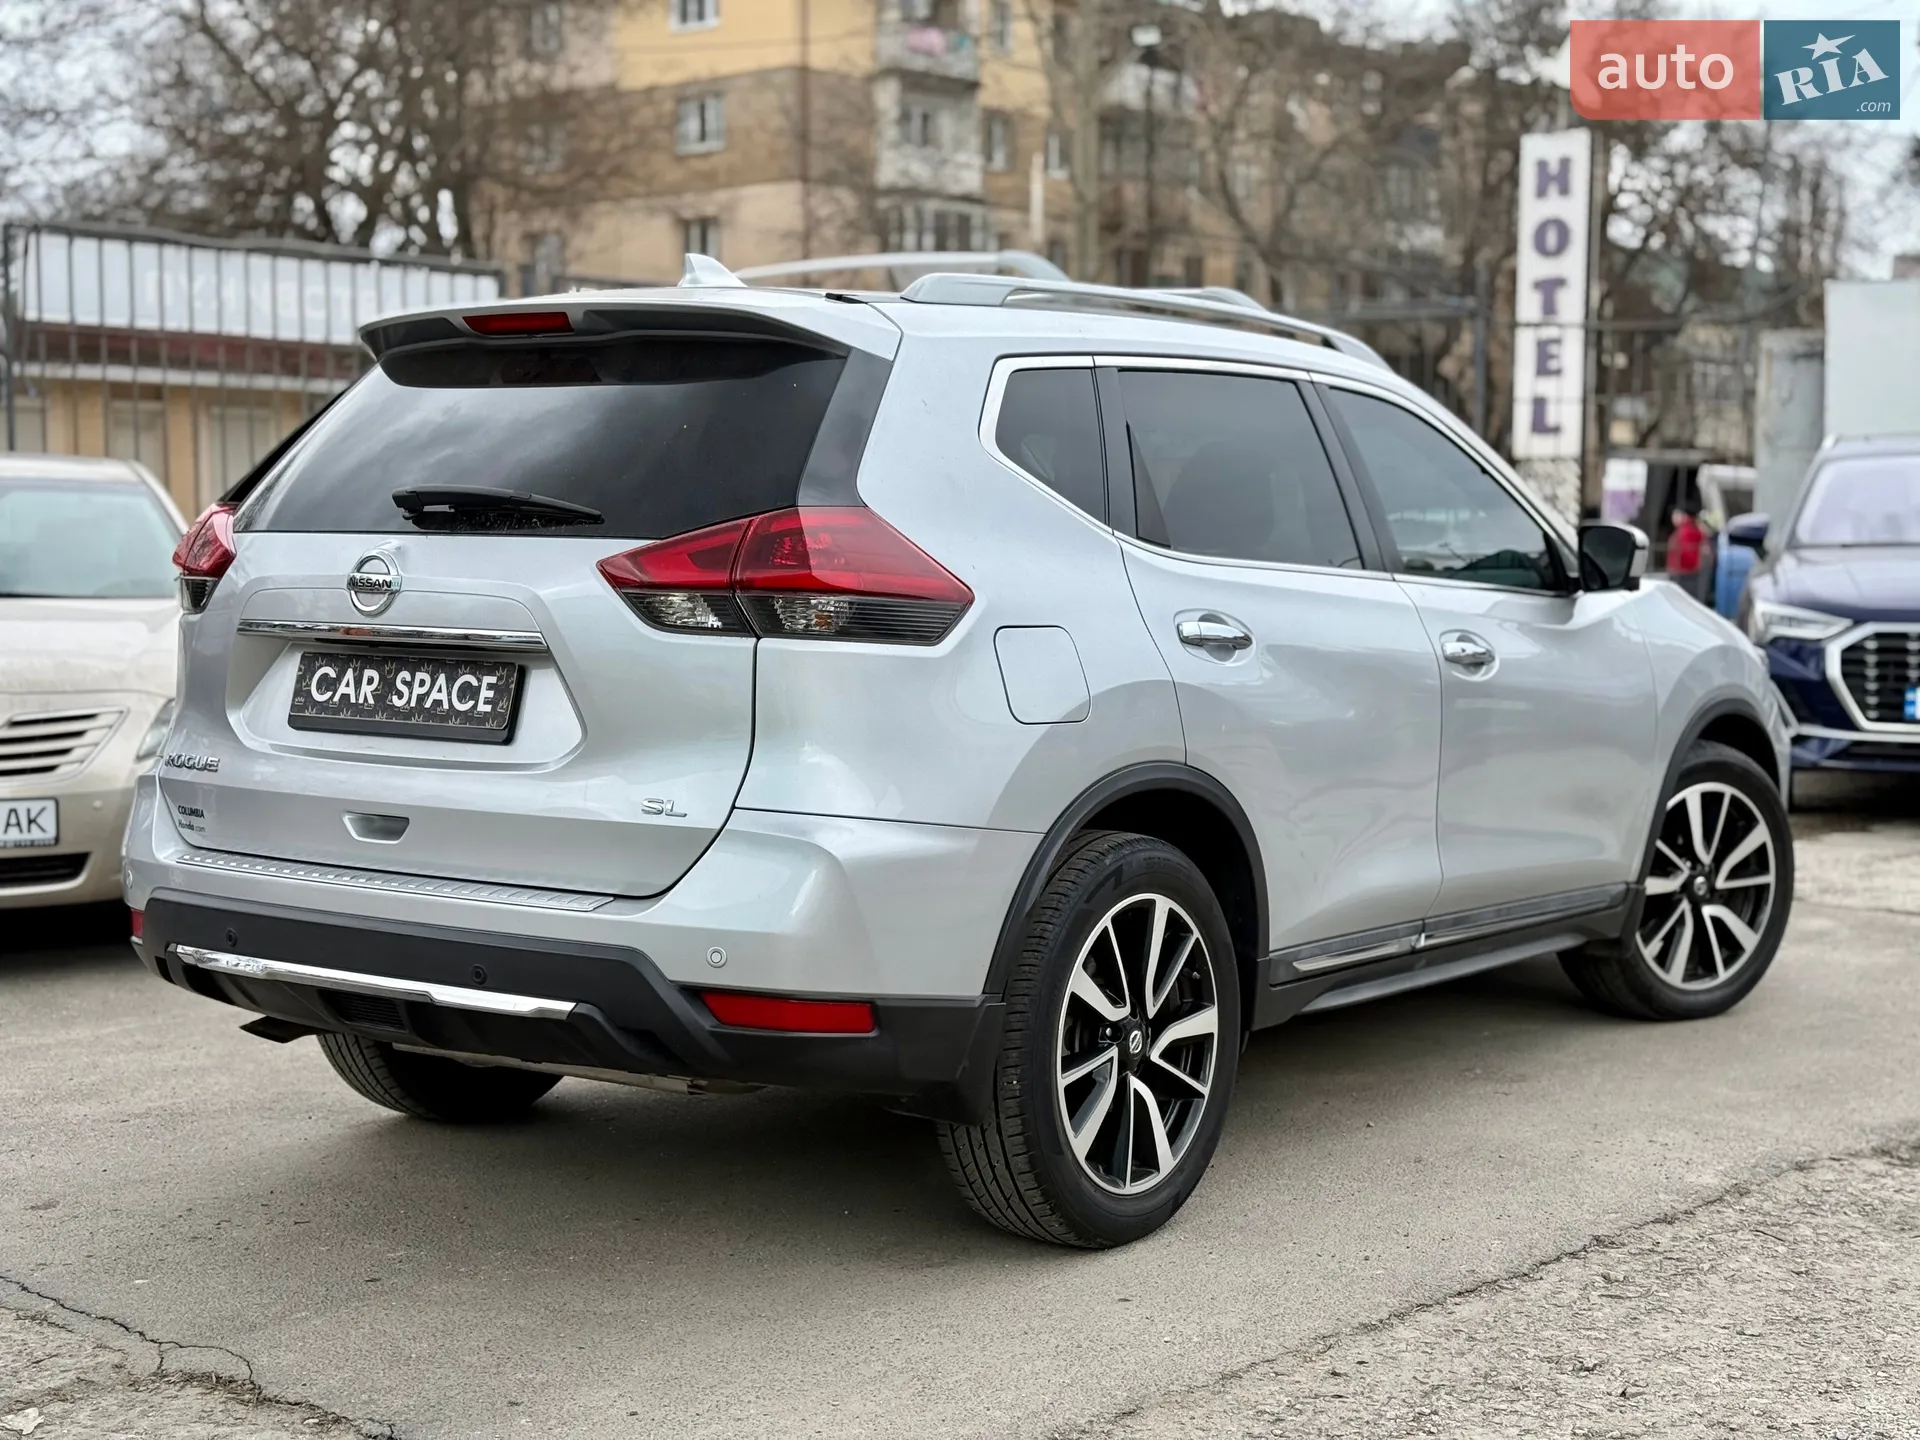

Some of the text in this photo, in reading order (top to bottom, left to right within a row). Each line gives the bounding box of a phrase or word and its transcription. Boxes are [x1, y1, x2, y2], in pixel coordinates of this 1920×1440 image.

[1532, 157, 1572, 435] HOTEL
[349, 575, 392, 588] NISSAN
[311, 666, 498, 712] CAR SPACE
[165, 752, 220, 773] ROGUE
[177, 804, 205, 819] COLUMBIA
[641, 797, 688, 818] SL
[4, 806, 47, 835] AK
